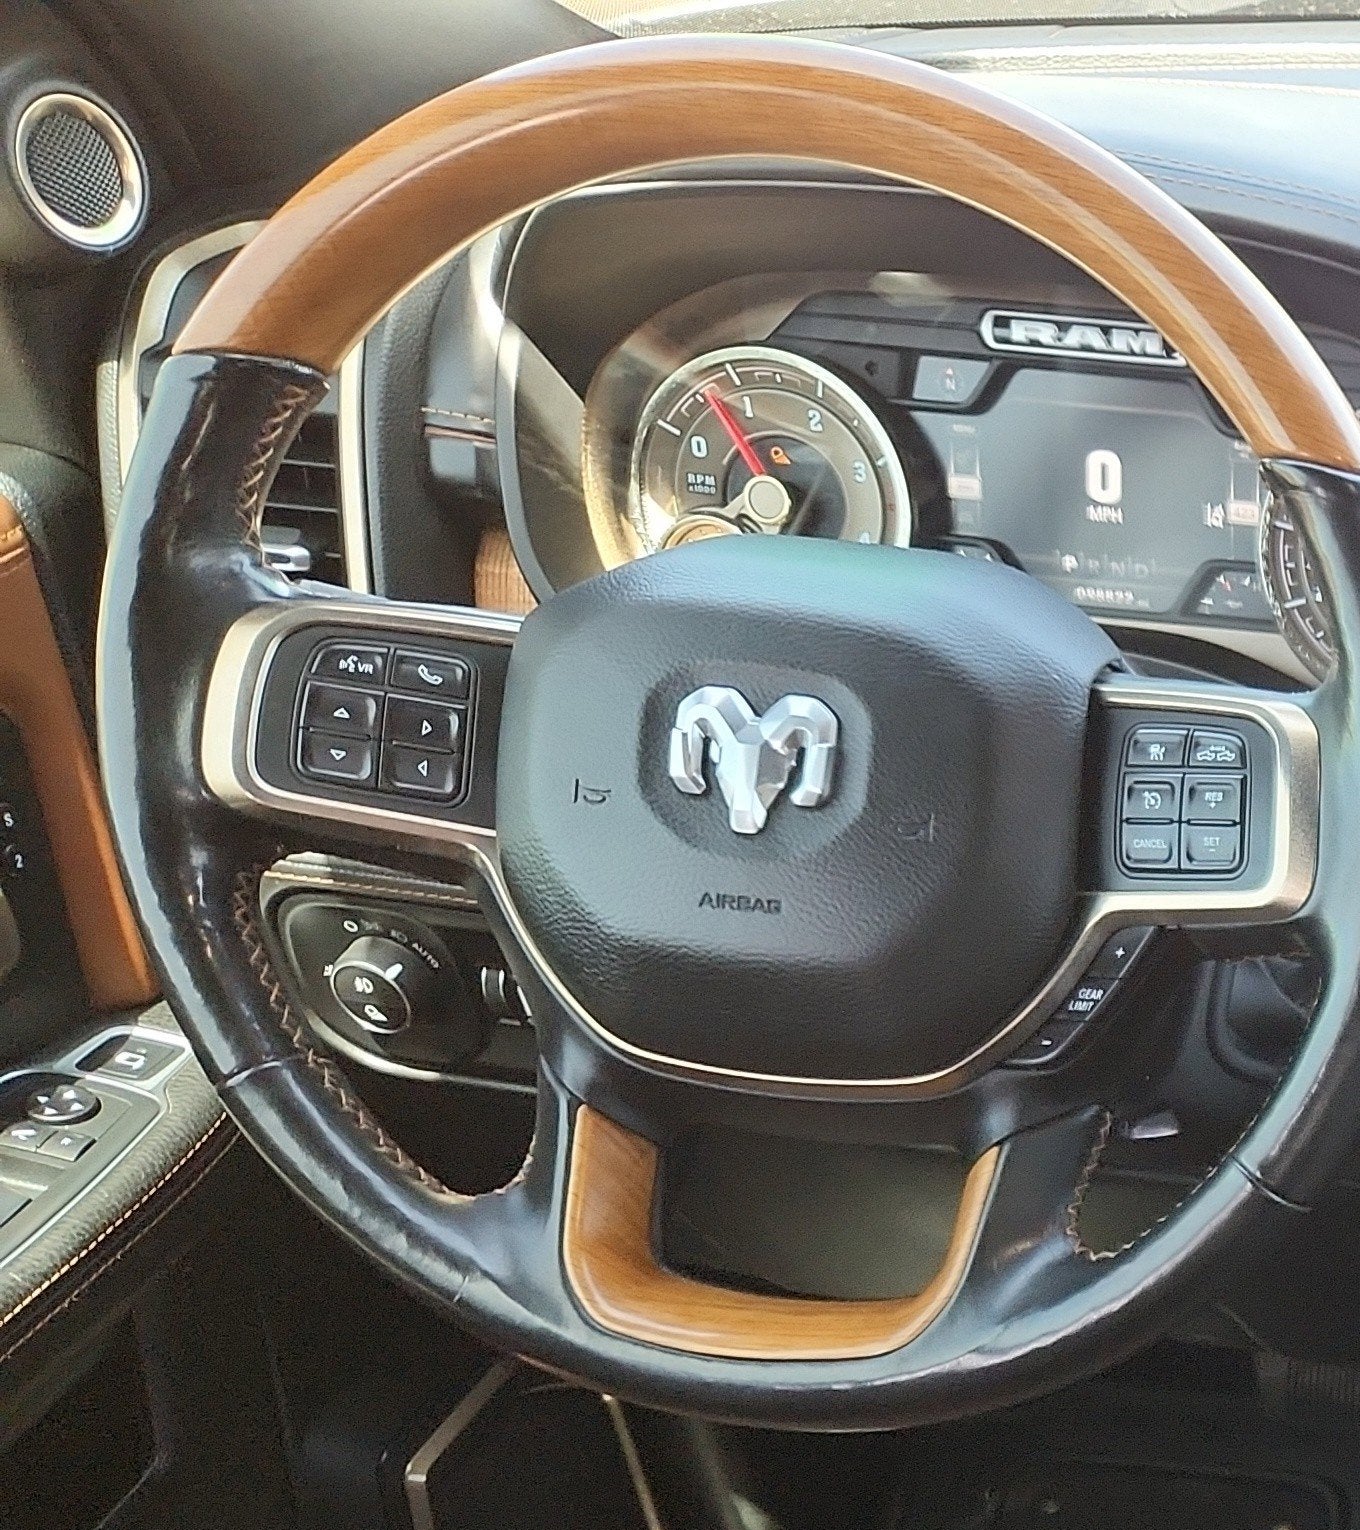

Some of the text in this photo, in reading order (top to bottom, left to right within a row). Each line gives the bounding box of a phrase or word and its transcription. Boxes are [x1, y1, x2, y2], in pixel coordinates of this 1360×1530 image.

[1009, 318, 1165, 356] RAM
[742, 395, 754, 419] 1
[807, 408, 823, 433] 2
[690, 435, 708, 459] 0
[687, 473, 716, 486] RPM
[852, 460, 868, 484] 3
[1084, 449, 1123, 506] 0
[1088, 504, 1124, 524] MPH
[1133, 838, 1168, 849] CANCEL
[1203, 836, 1221, 847] SET
[698, 891, 782, 915] AIRBAG
[1078, 987, 1104, 1000] GEAR
[1068, 1000, 1095, 1012] LIMIT
